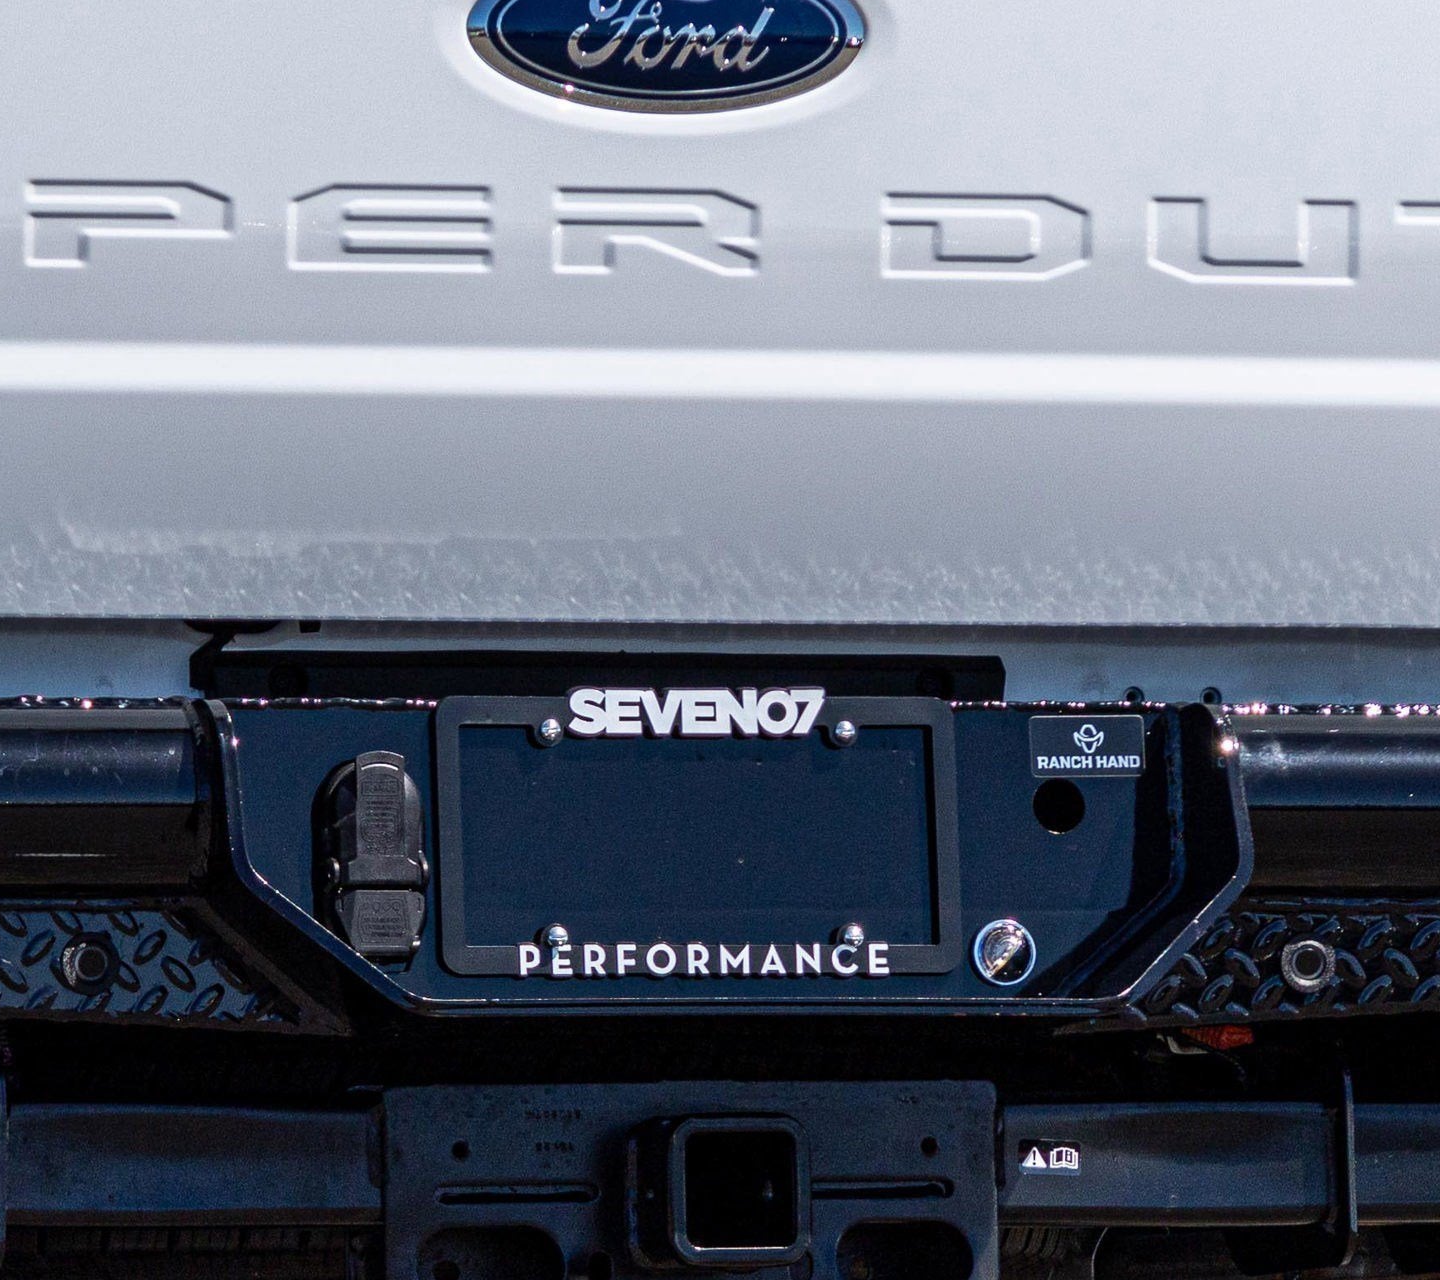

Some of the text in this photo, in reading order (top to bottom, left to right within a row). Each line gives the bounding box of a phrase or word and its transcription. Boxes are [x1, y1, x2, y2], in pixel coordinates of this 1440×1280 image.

[1036, 755, 1141, 769] RANCH HAND
[519, 942, 890, 977] PERFORMANCE
